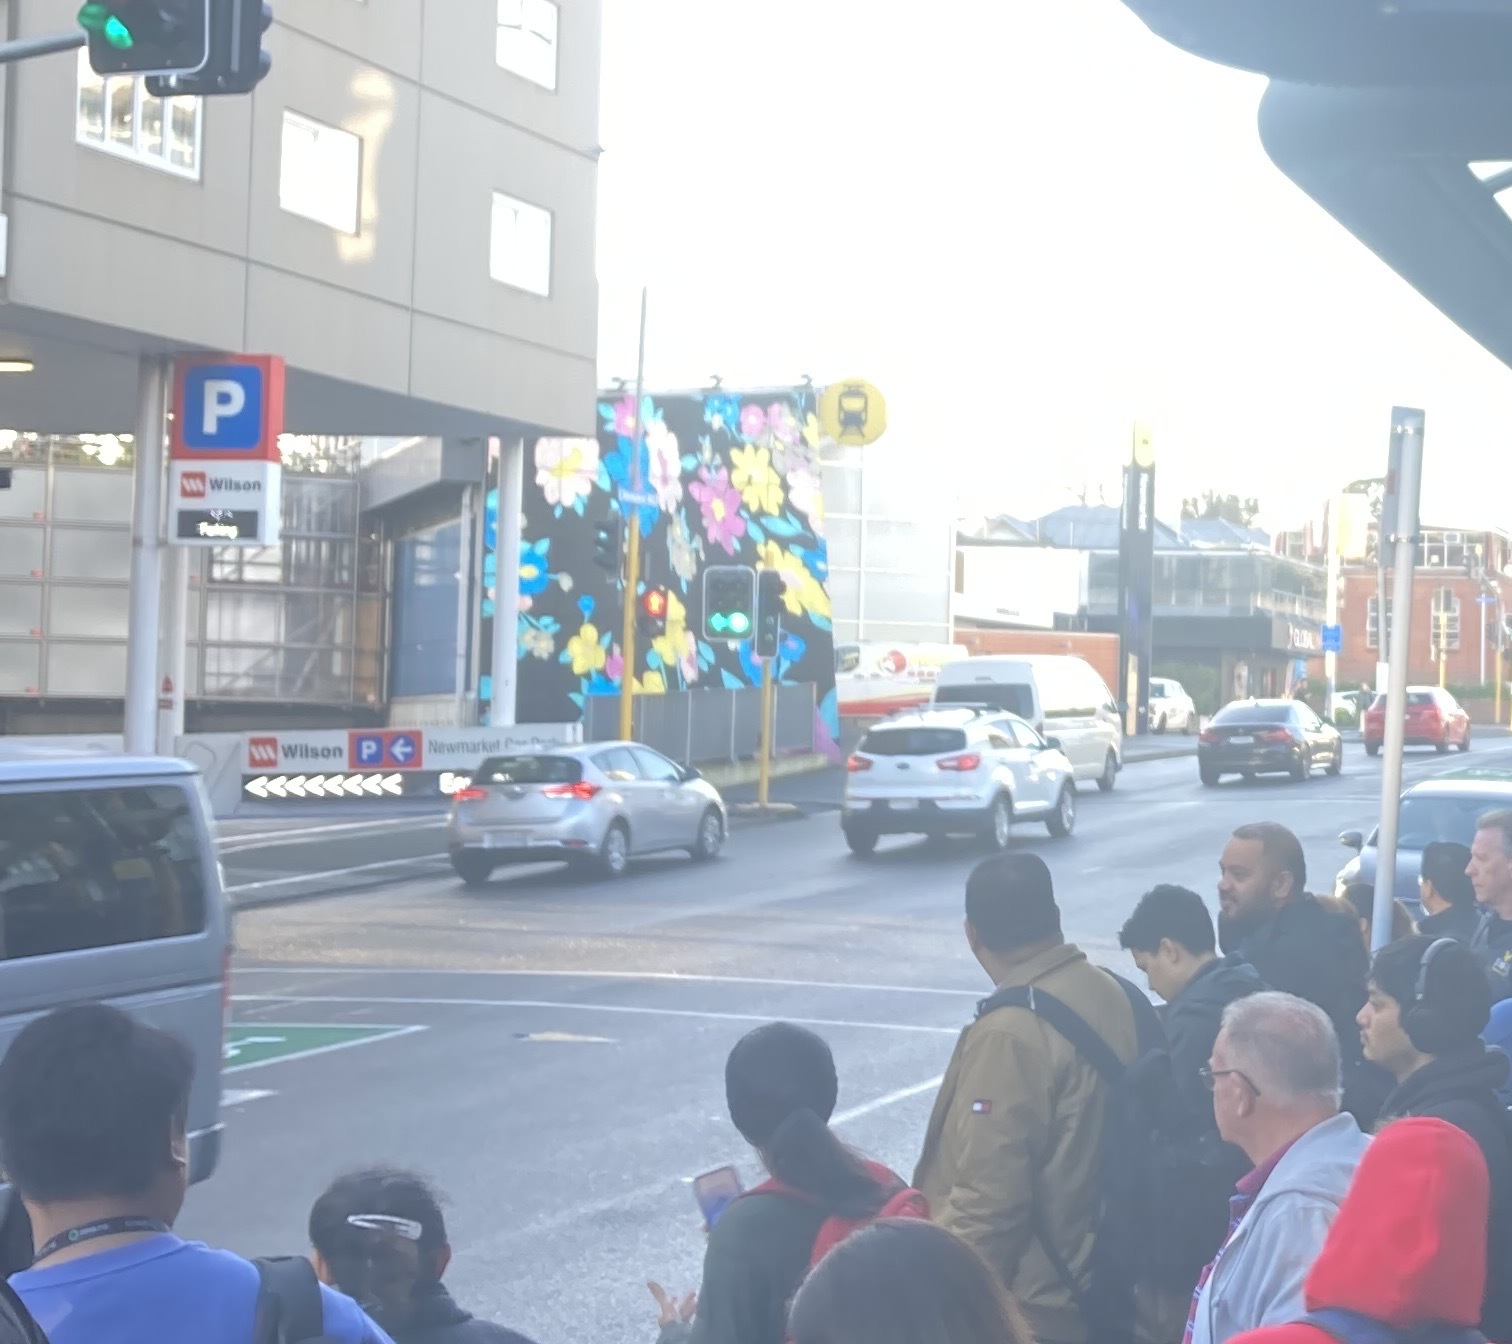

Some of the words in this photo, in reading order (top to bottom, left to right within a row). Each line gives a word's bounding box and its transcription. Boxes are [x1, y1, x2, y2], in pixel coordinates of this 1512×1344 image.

[203, 379, 246, 435] P
[209, 477, 262, 492] Wilson
[281, 742, 344, 760] Wilson
[428, 738, 500, 755] Newmarket
